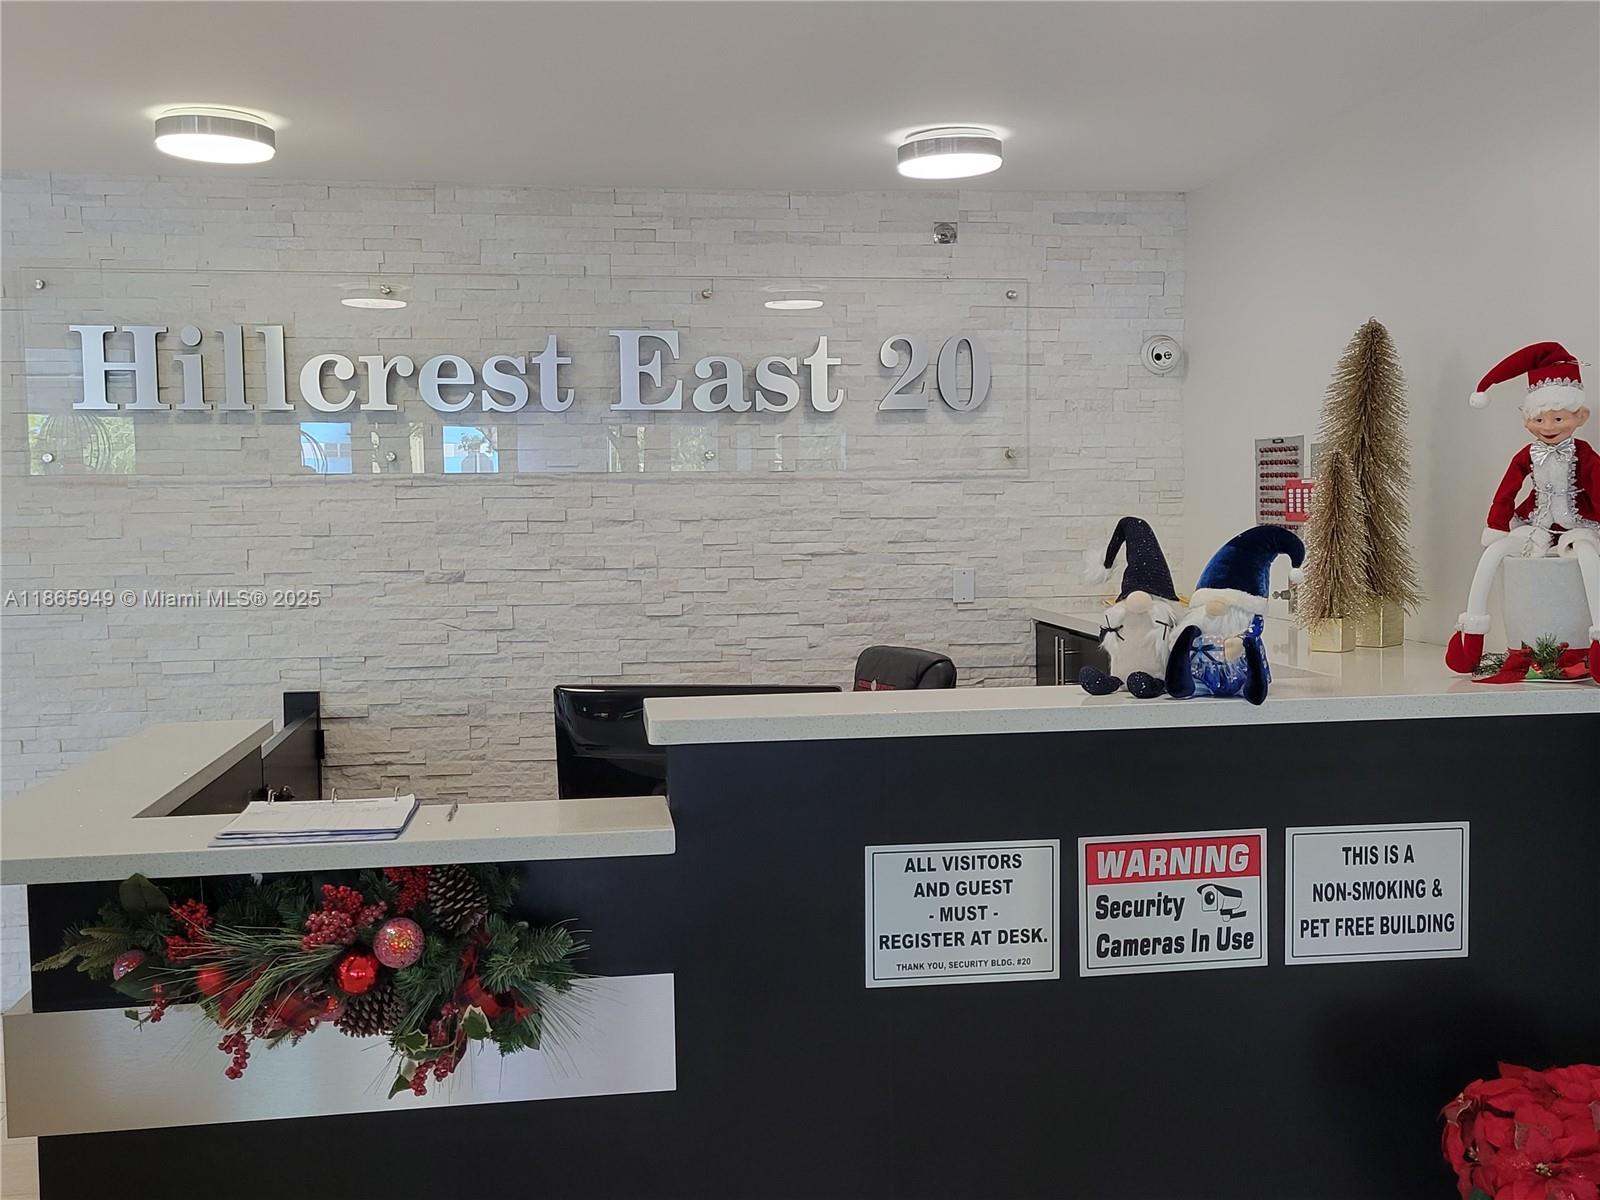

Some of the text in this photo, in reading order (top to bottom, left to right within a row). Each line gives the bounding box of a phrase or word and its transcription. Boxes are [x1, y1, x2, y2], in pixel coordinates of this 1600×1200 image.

[69, 324, 992, 413] Hillcrest East 20
[904, 853, 1022, 873] ALL VISITORS
[1097, 843, 1250, 879] WARNING
[1342, 844, 1415, 866] THIS IS A
[913, 879, 1014, 898] AND GUEST
[1312, 878, 1443, 902] NON-SMOKING &
[939, 905, 988, 922] MUST
[1095, 892, 1185, 921] Security
[1300, 913, 1455, 938] PET FREE BUILDING
[879, 927, 1048, 950] REGISTER AT DESK.
[1096, 926, 1254, 958] Cameras In Use
[896, 957, 1031, 971] THANK YOU, SECURITY BLDG. #20
